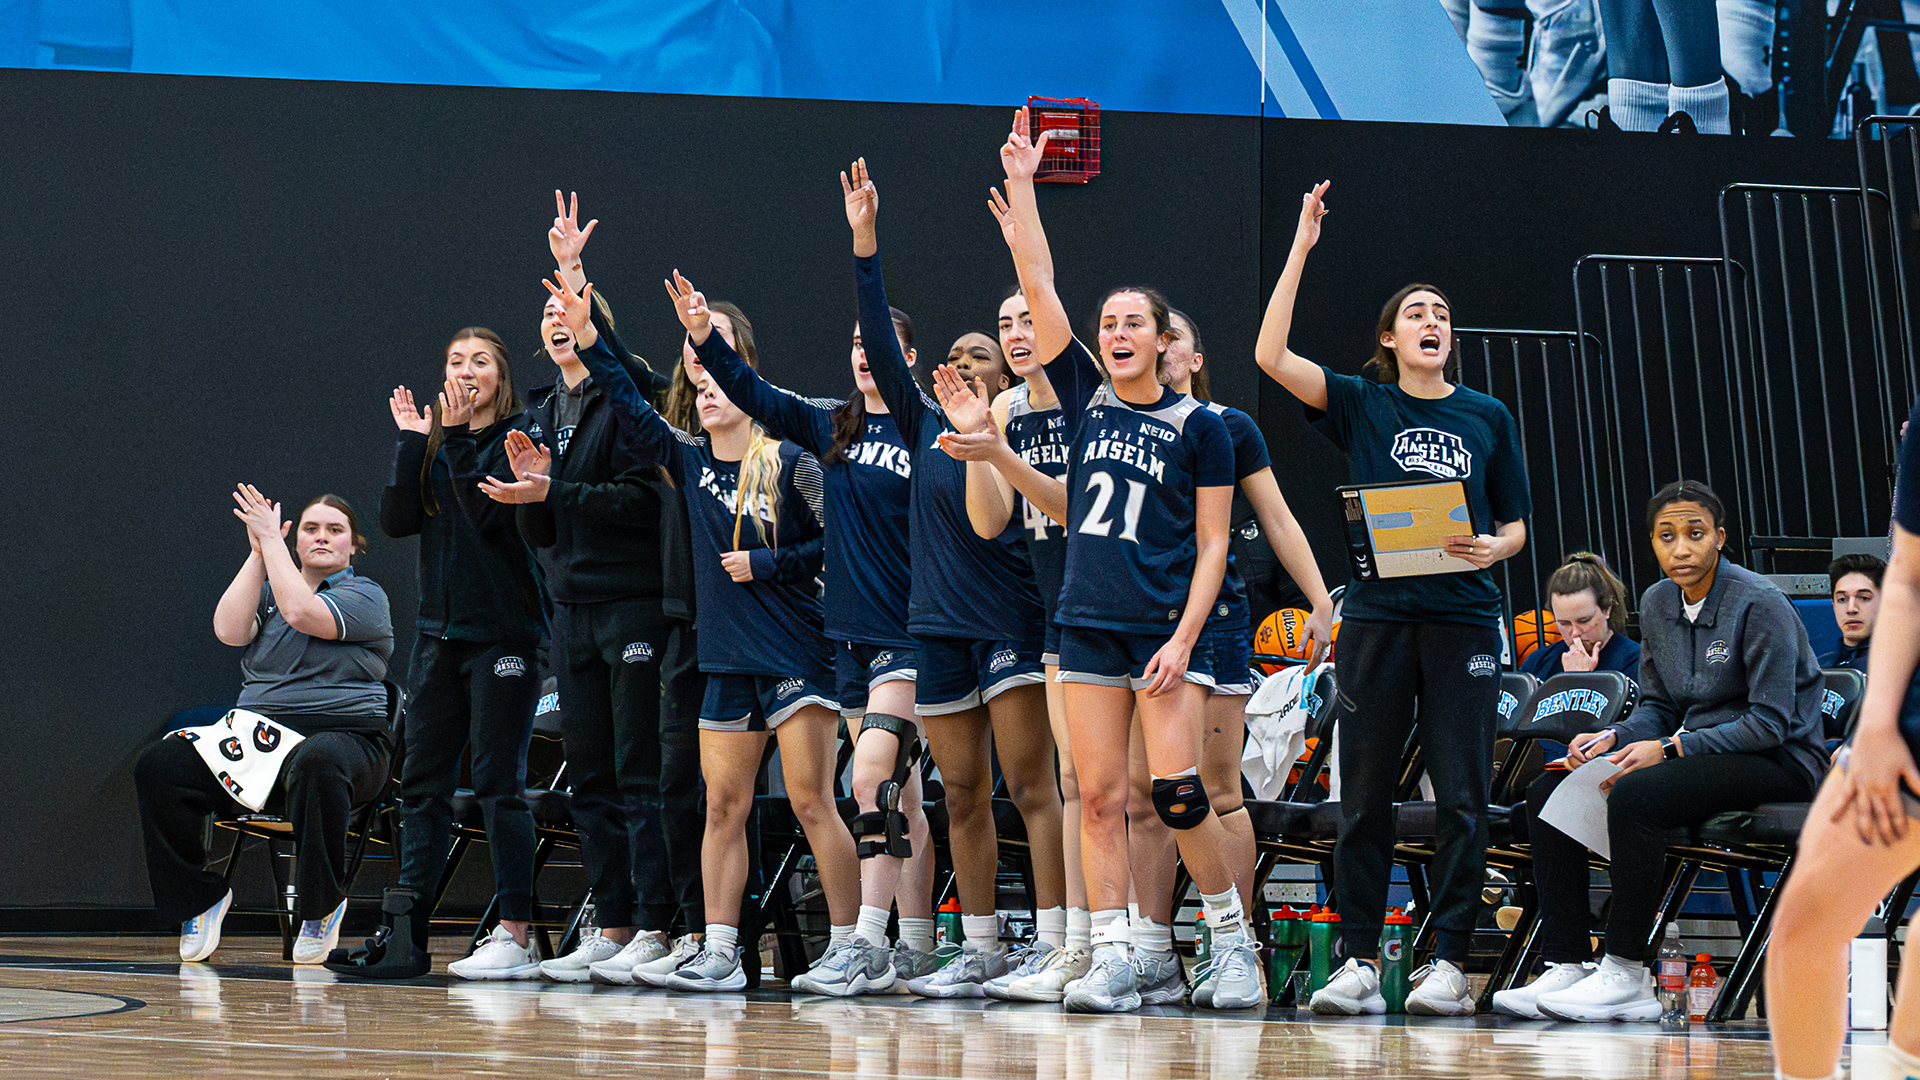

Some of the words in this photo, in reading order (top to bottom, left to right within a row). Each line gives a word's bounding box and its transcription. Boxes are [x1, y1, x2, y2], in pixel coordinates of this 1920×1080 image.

[1098, 429, 1158, 453] SAINT
[1139, 422, 1176, 443] NE10
[1415, 432, 1457, 447] AINT
[1016, 444, 1070, 466] NSELM
[1083, 439, 1167, 485] ANSELM
[1078, 471, 1148, 545] 21
[1281, 609, 1298, 650] Wilson
[1531, 688, 1609, 722] BENTLEY
